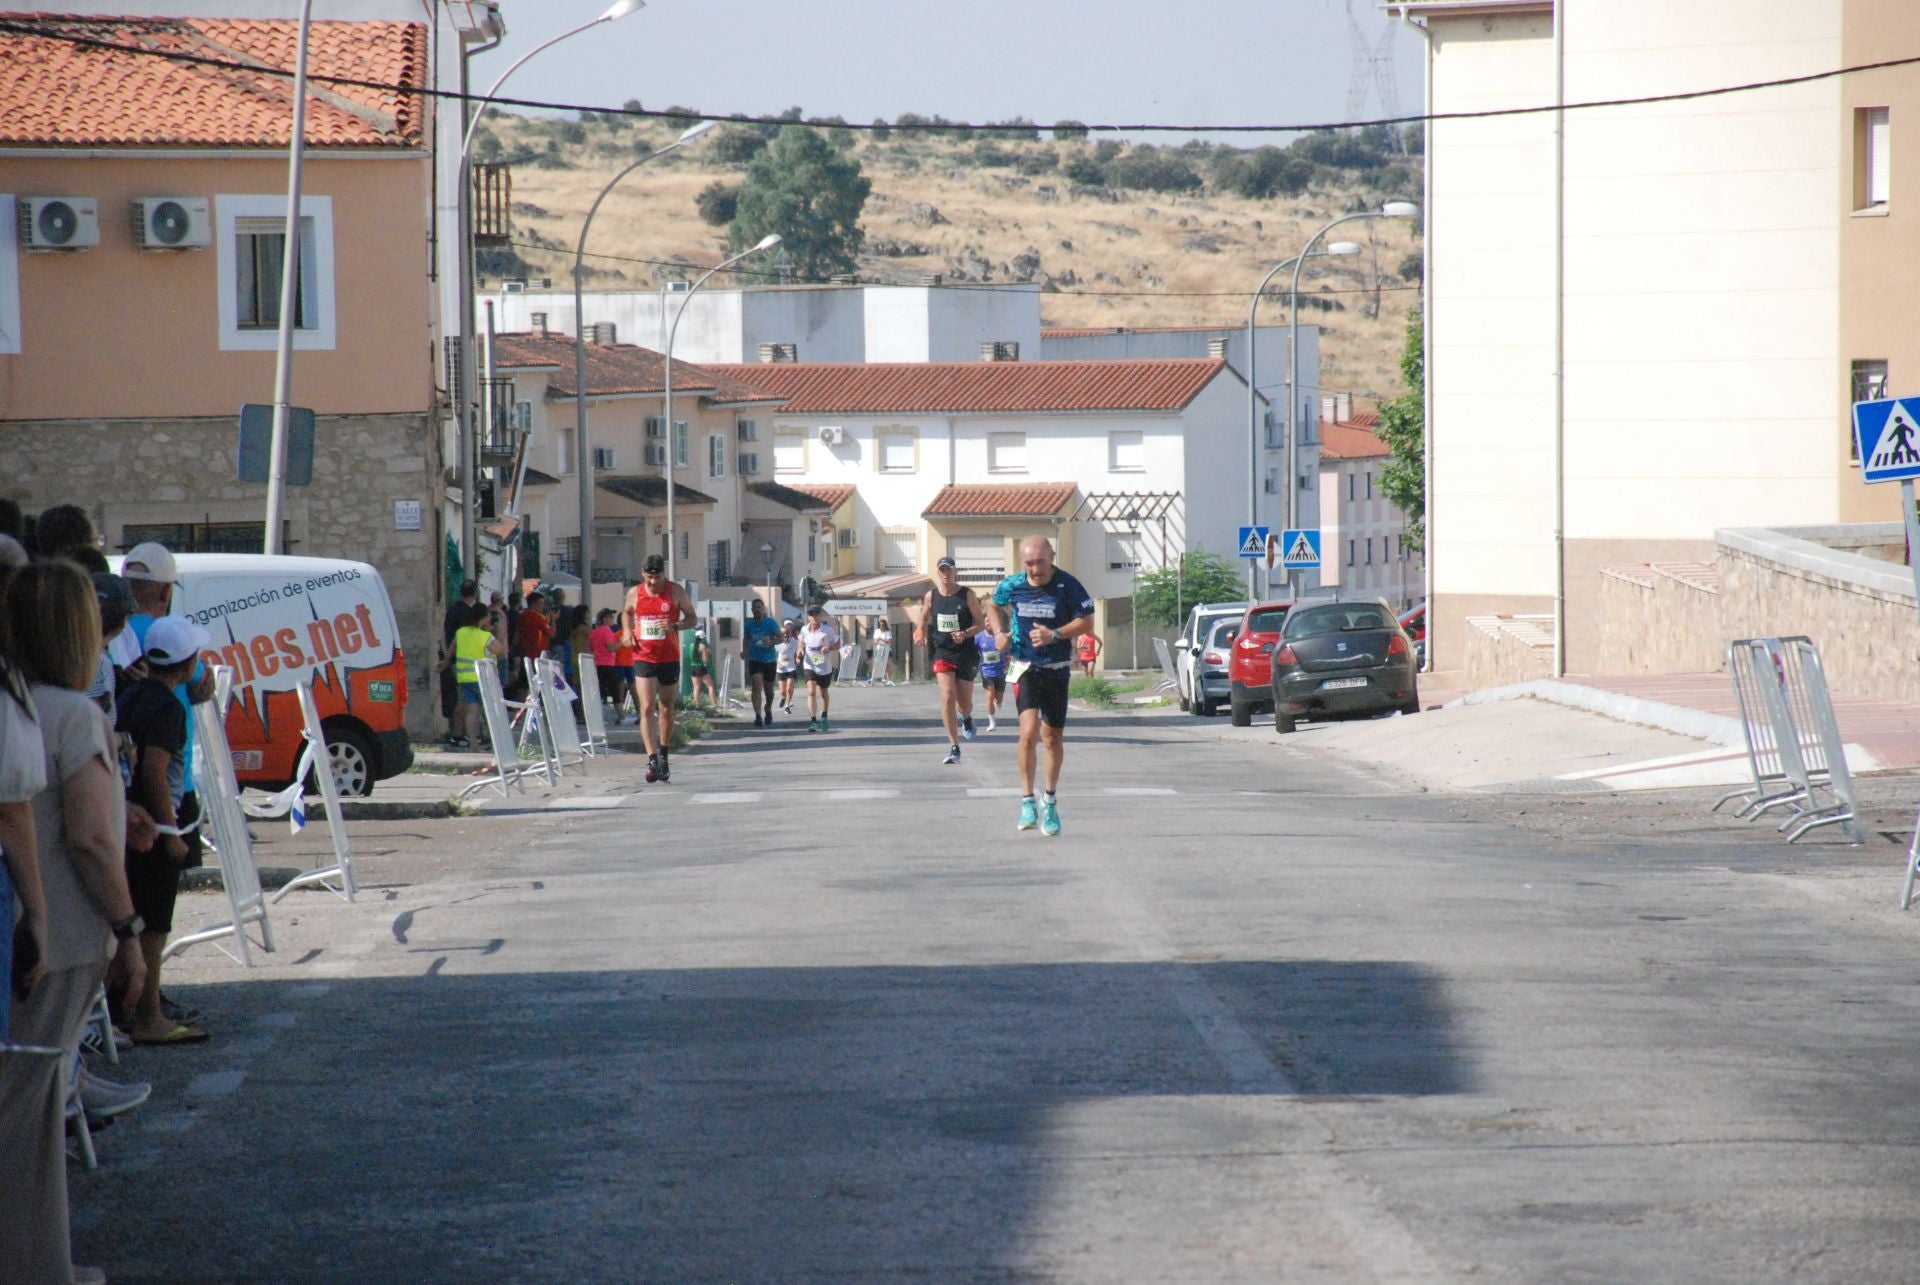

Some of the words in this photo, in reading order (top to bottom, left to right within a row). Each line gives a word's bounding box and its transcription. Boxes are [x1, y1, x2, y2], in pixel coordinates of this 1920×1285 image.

[185, 588, 280, 625] organización
[283, 582, 303, 598] de
[306, 568, 361, 592] eventos
